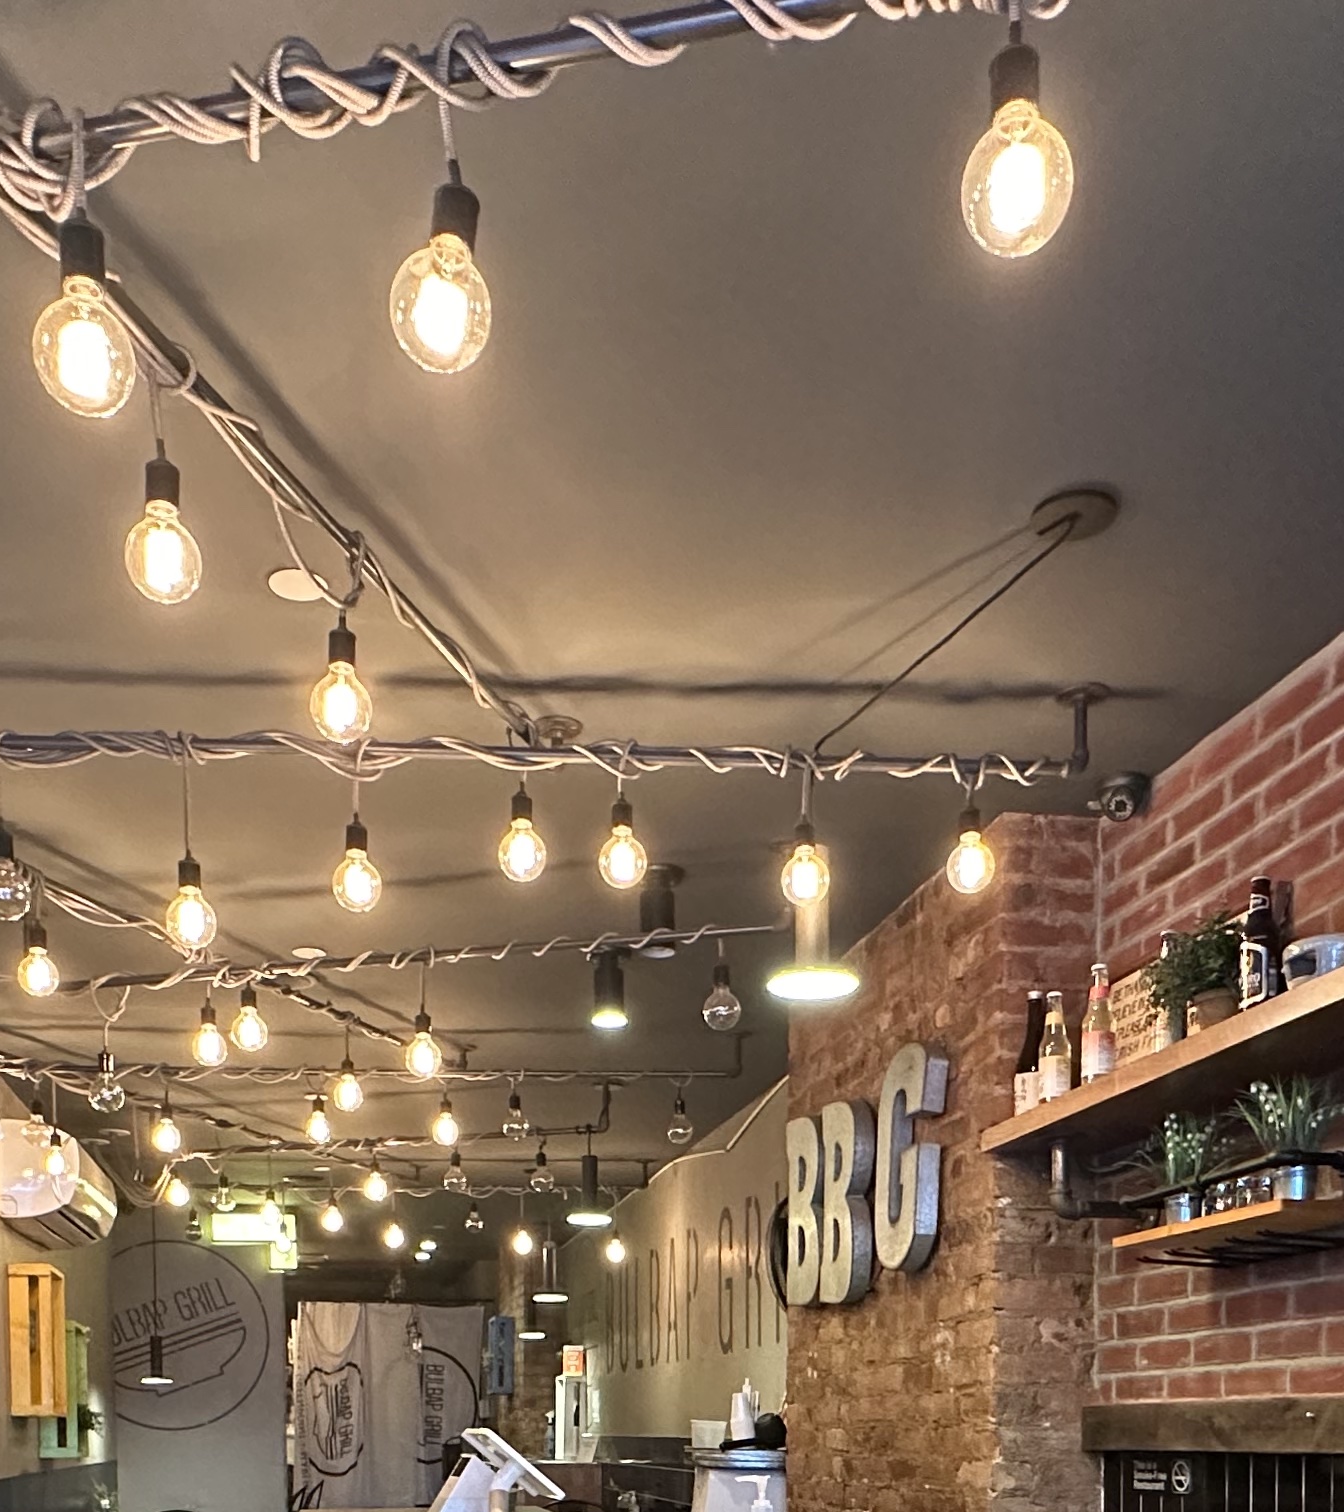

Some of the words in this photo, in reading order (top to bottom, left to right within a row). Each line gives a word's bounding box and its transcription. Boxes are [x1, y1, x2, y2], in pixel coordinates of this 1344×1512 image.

[785, 1042, 949, 1308] BBG
[111, 1299, 168, 1347] ULBAP
[173, 1277, 236, 1321] GRILL
[606, 1227, 699, 1375] BULBAP
[718, 1180, 781, 1355] GRI
[425, 1363, 444, 1412] BULBAP
